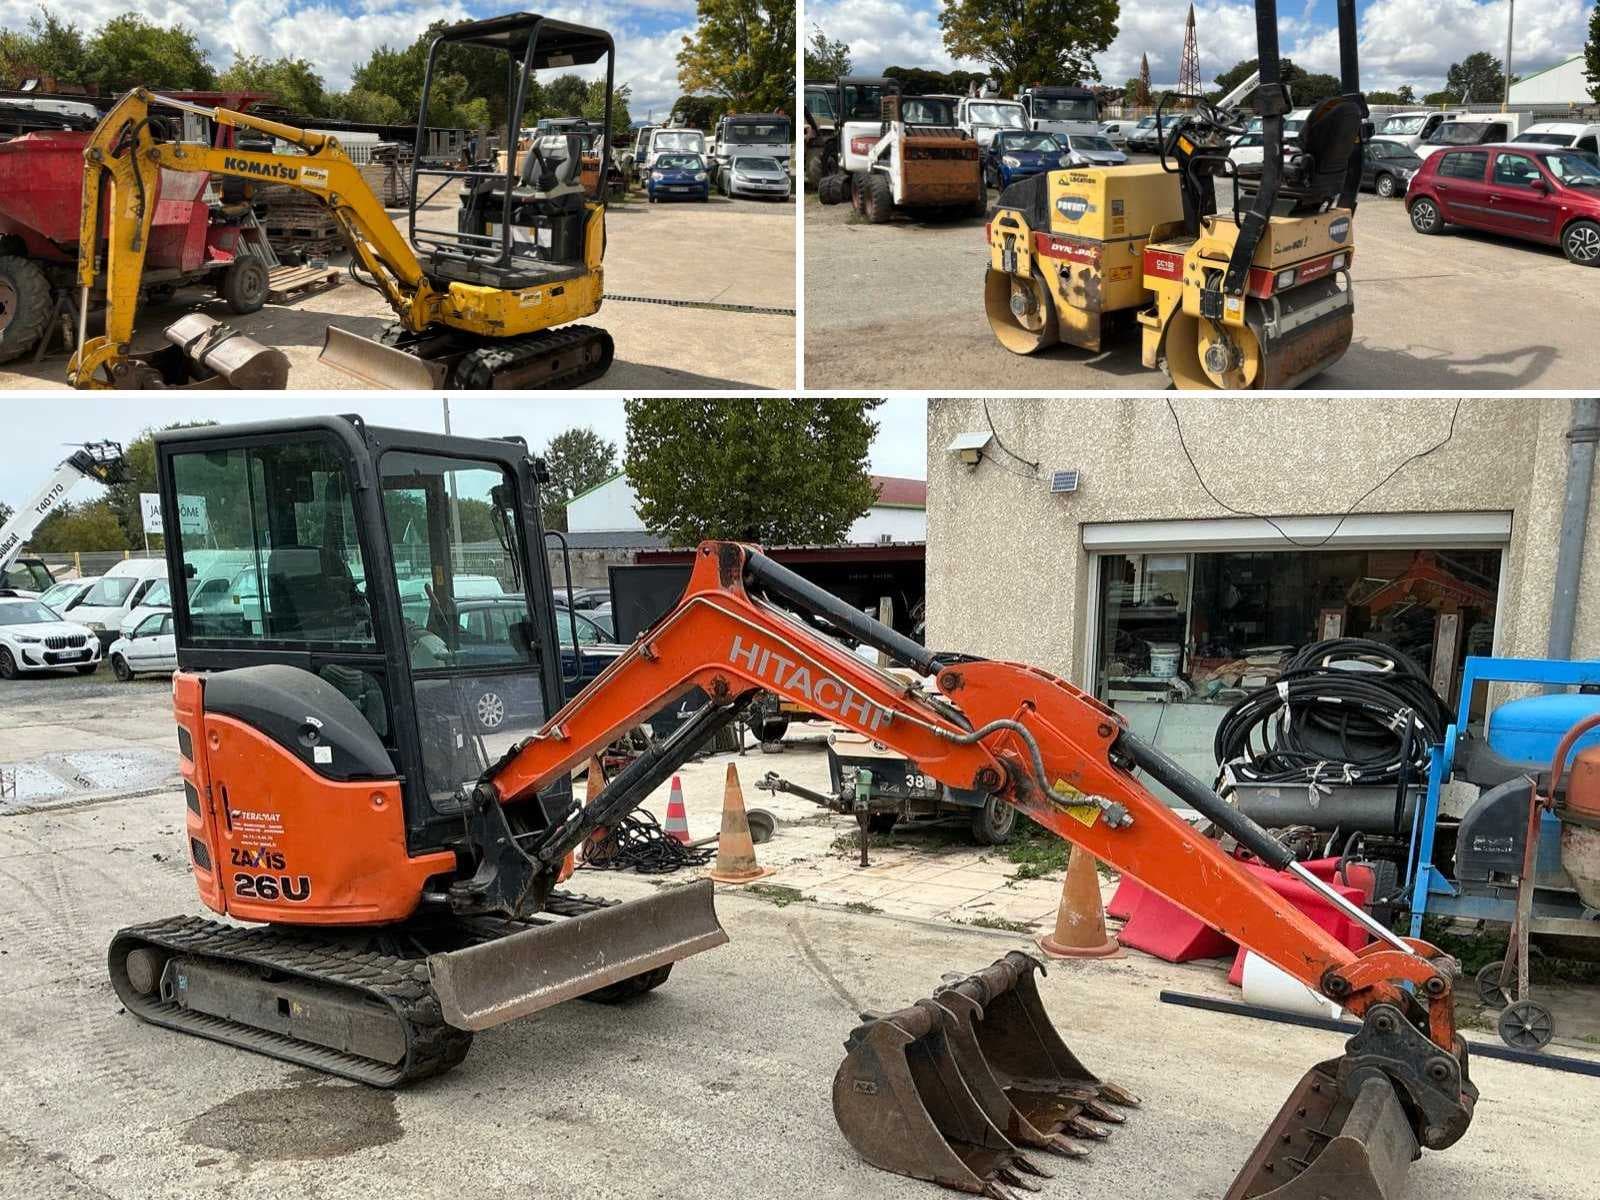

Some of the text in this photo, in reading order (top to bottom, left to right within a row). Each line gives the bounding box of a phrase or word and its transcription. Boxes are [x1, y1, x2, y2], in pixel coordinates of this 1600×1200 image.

[224, 156, 298, 180] KOMATSU
[1051, 243, 1098, 258] DYNPAC
[35, 483, 65, 514] T40170
[150, 503, 200, 518] JA ÔME
[728, 635, 886, 732] HITACHI
[904, 774, 925, 789] 38
[233, 872, 312, 903] 26U
